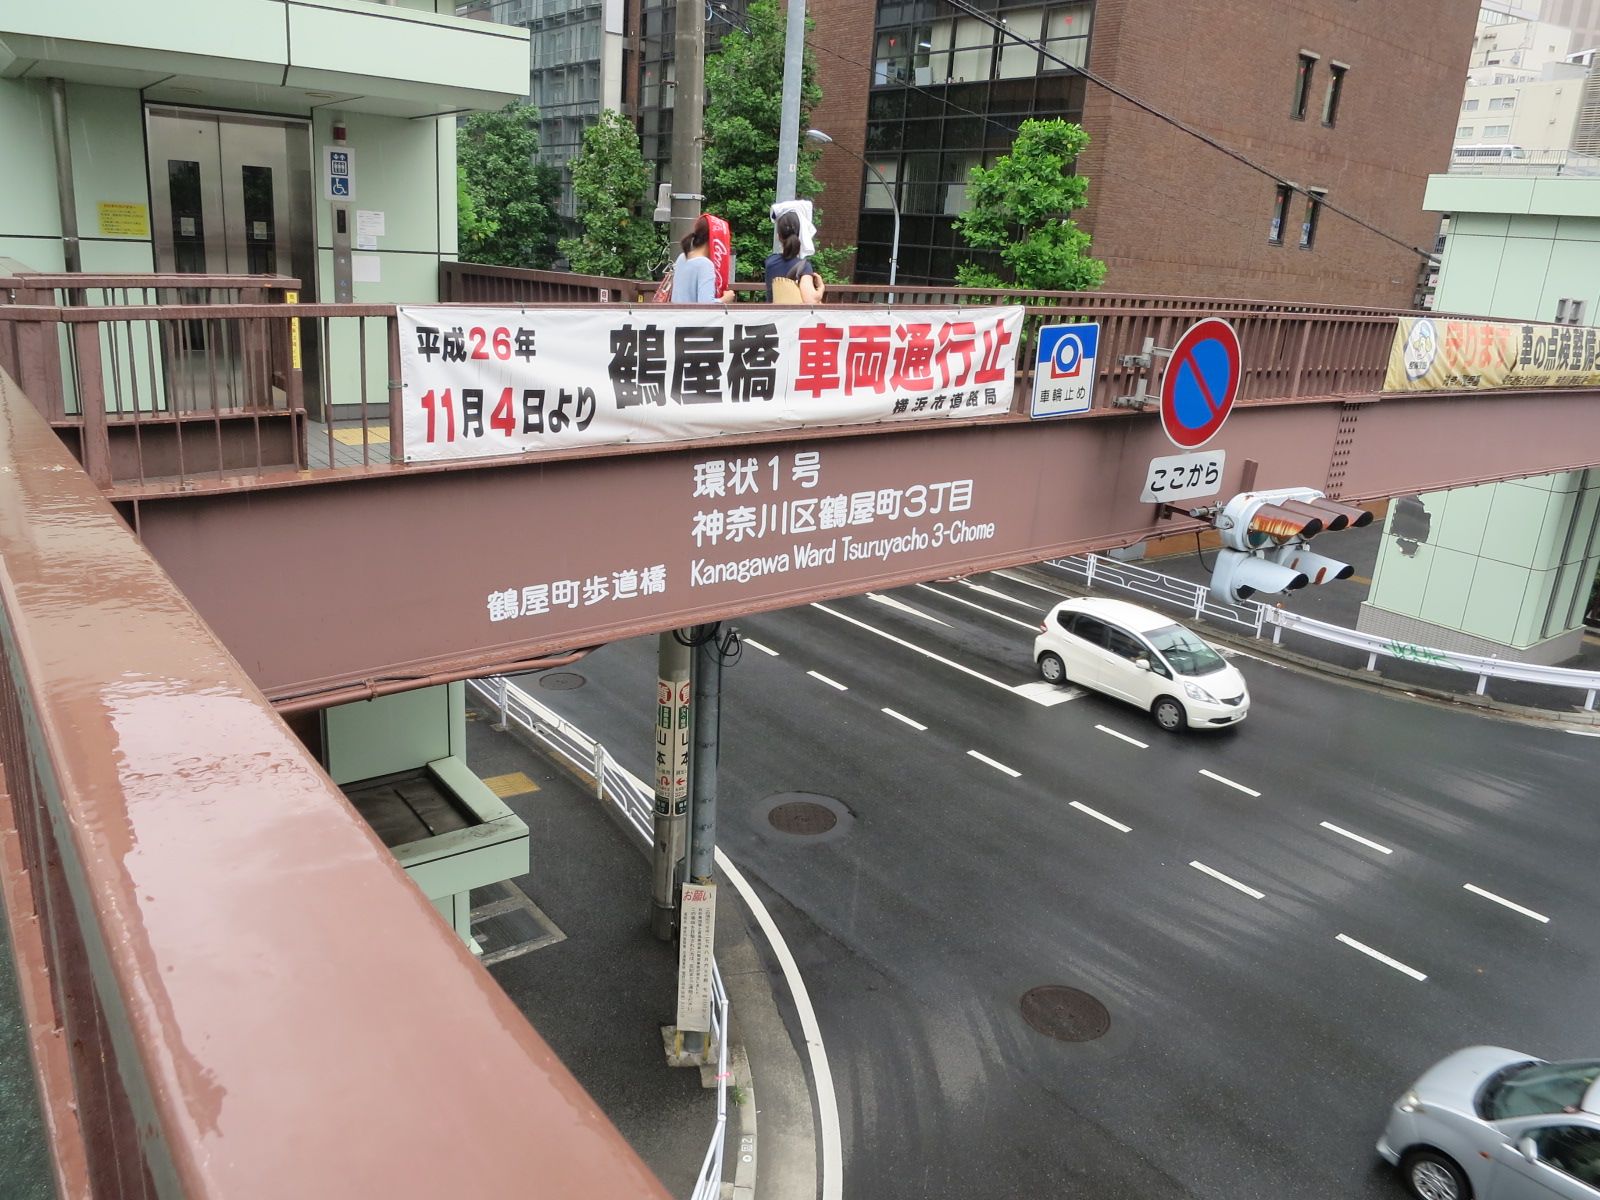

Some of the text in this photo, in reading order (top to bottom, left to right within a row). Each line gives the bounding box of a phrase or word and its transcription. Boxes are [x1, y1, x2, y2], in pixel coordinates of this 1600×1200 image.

[417, 325, 536, 364] 平成26年
[608, 318, 1014, 410] 鶴屋橋 車両通行止
[421, 386, 597, 443] 11月4日より
[892, 389, 998, 416] 横浜市道路局
[1040, 385, 1086, 403] 車輪止め
[693, 451, 822, 499] 環状1号
[1150, 461, 1219, 492] ここから
[691, 479, 974, 549] 神奈川区鶴屋町3丁目
[691, 522, 995, 587] Kanagawa Ward Tsuruyacho 3-Chome
[487, 563, 667, 622] 鶴屋町歩道橋
[683, 890, 712, 902] お願い
